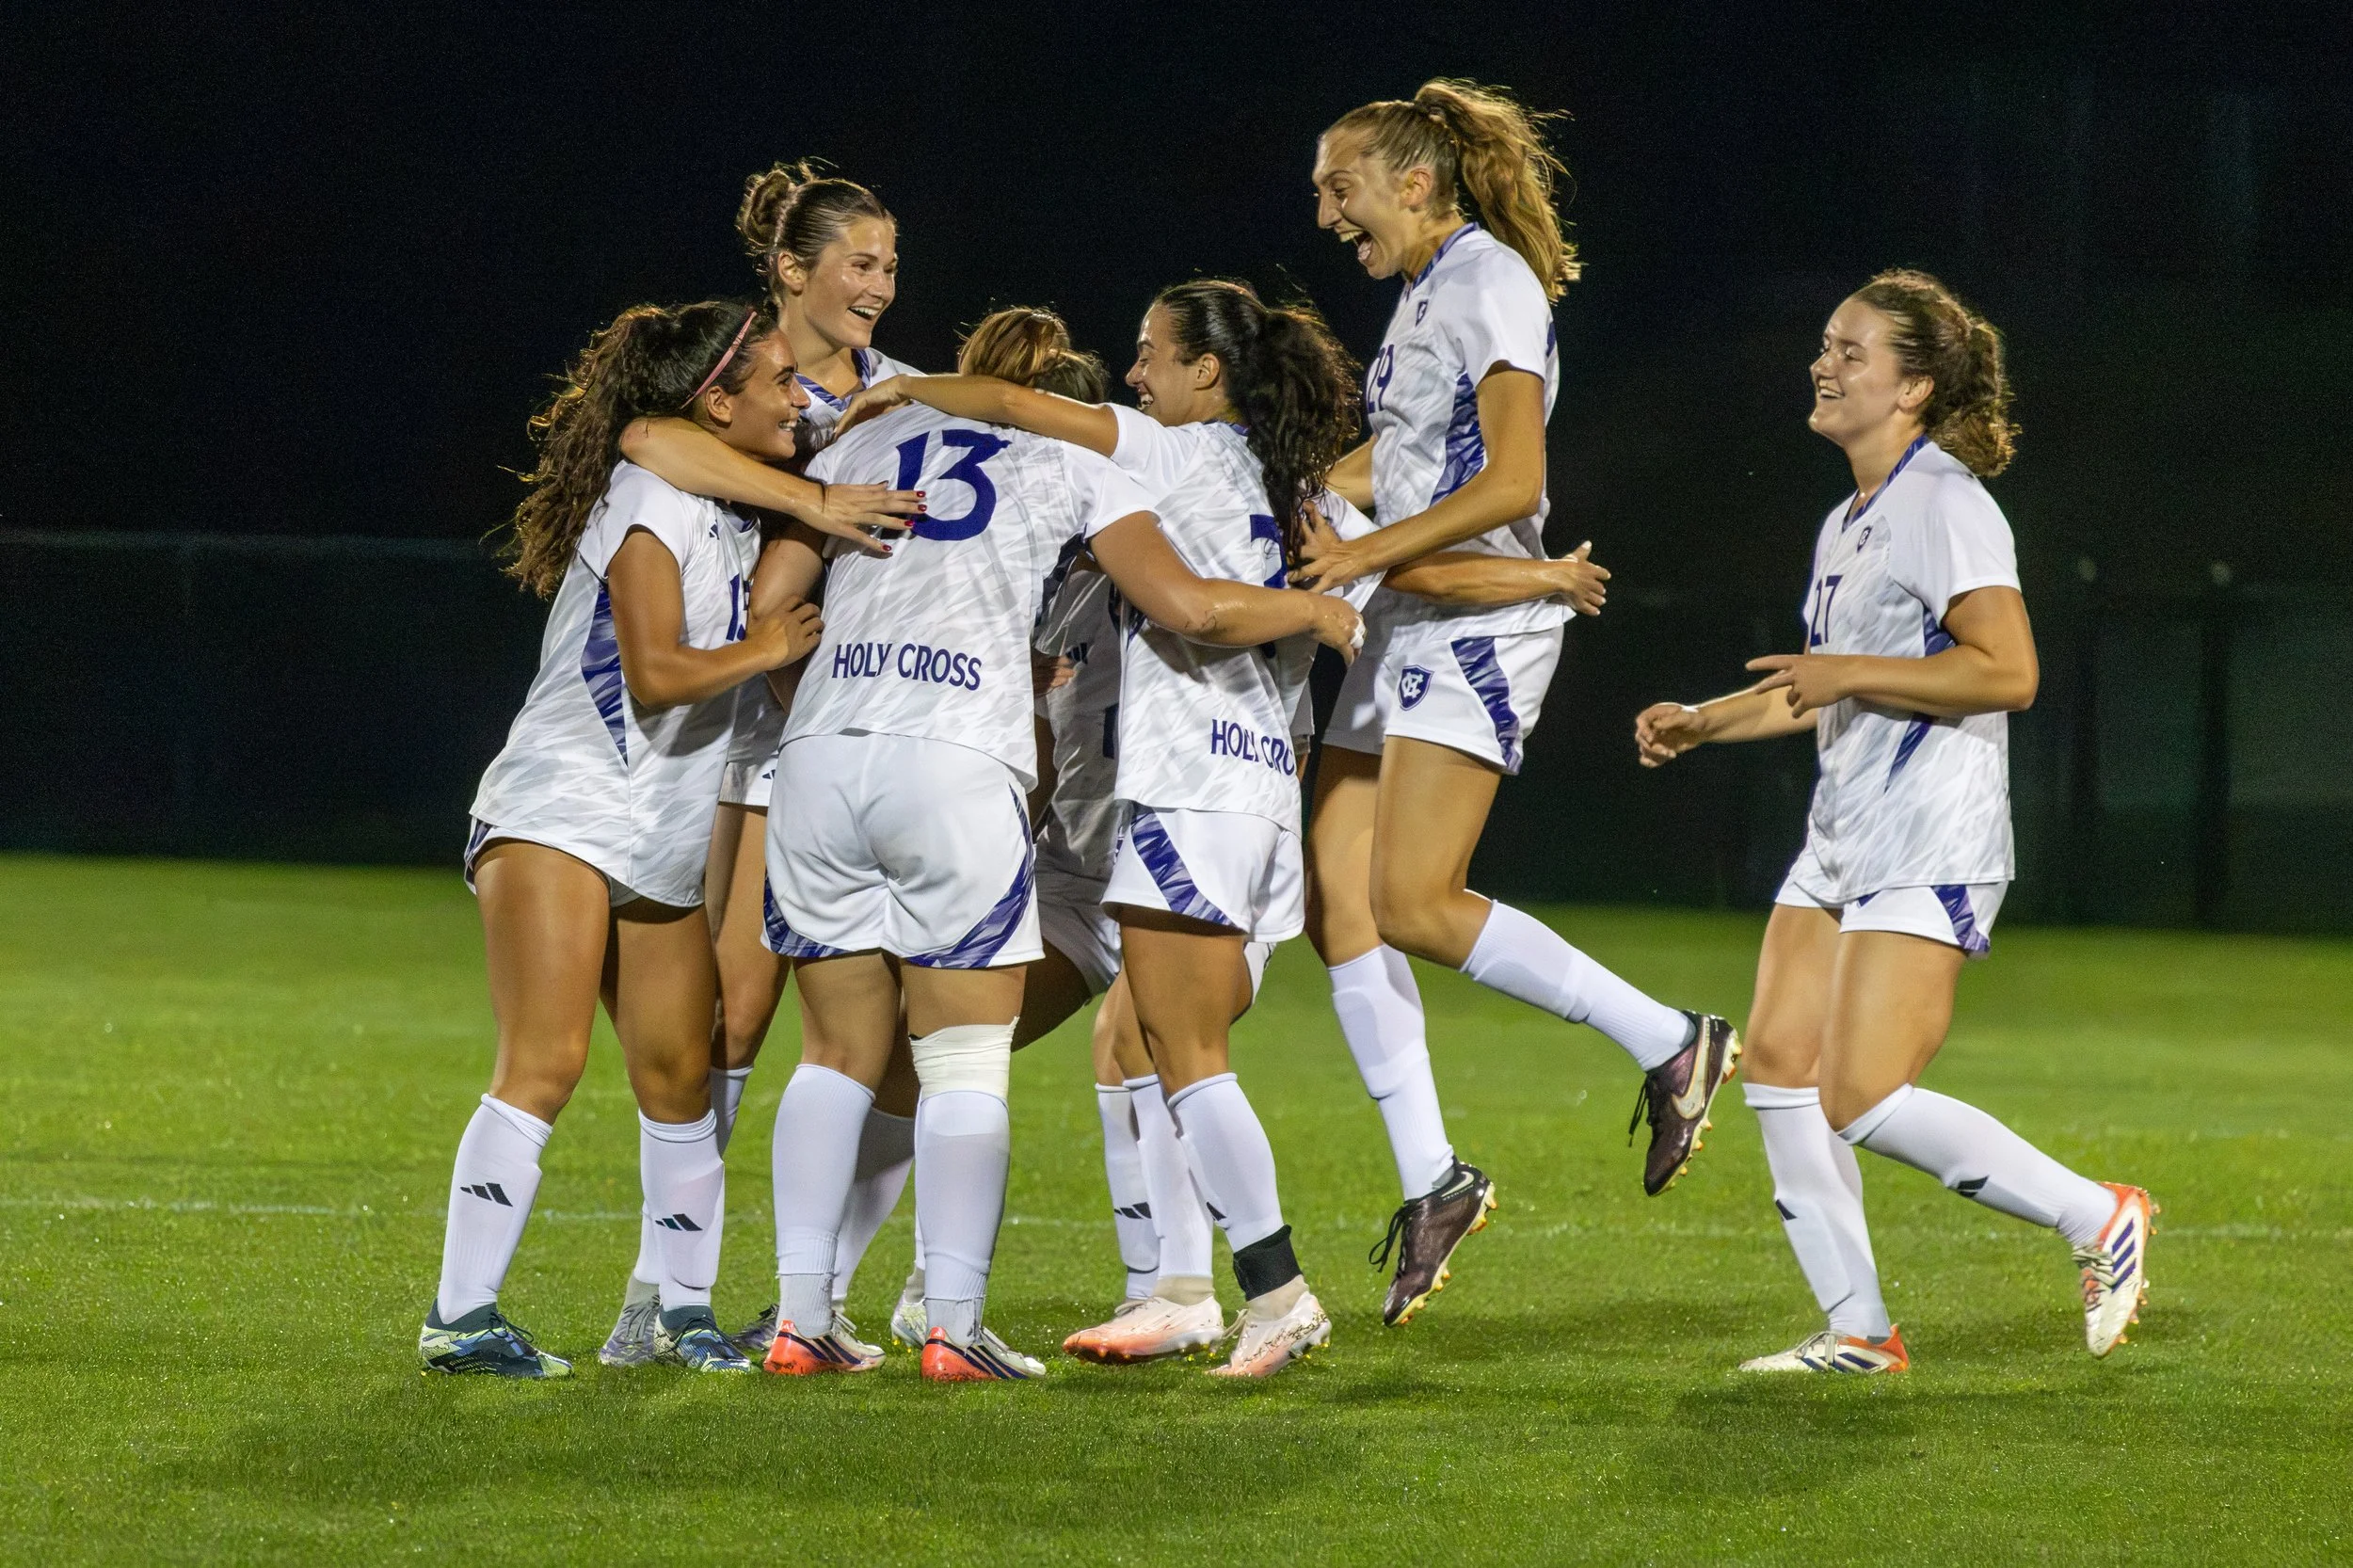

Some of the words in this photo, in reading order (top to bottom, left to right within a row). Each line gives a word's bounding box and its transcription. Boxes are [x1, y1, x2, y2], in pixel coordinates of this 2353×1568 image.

[896, 428, 1013, 541] 13
[1810, 574, 1844, 648] 27
[832, 642, 893, 680] HOLY
[898, 643, 983, 692] CROSS
[1261, 736, 1295, 776] CRO
